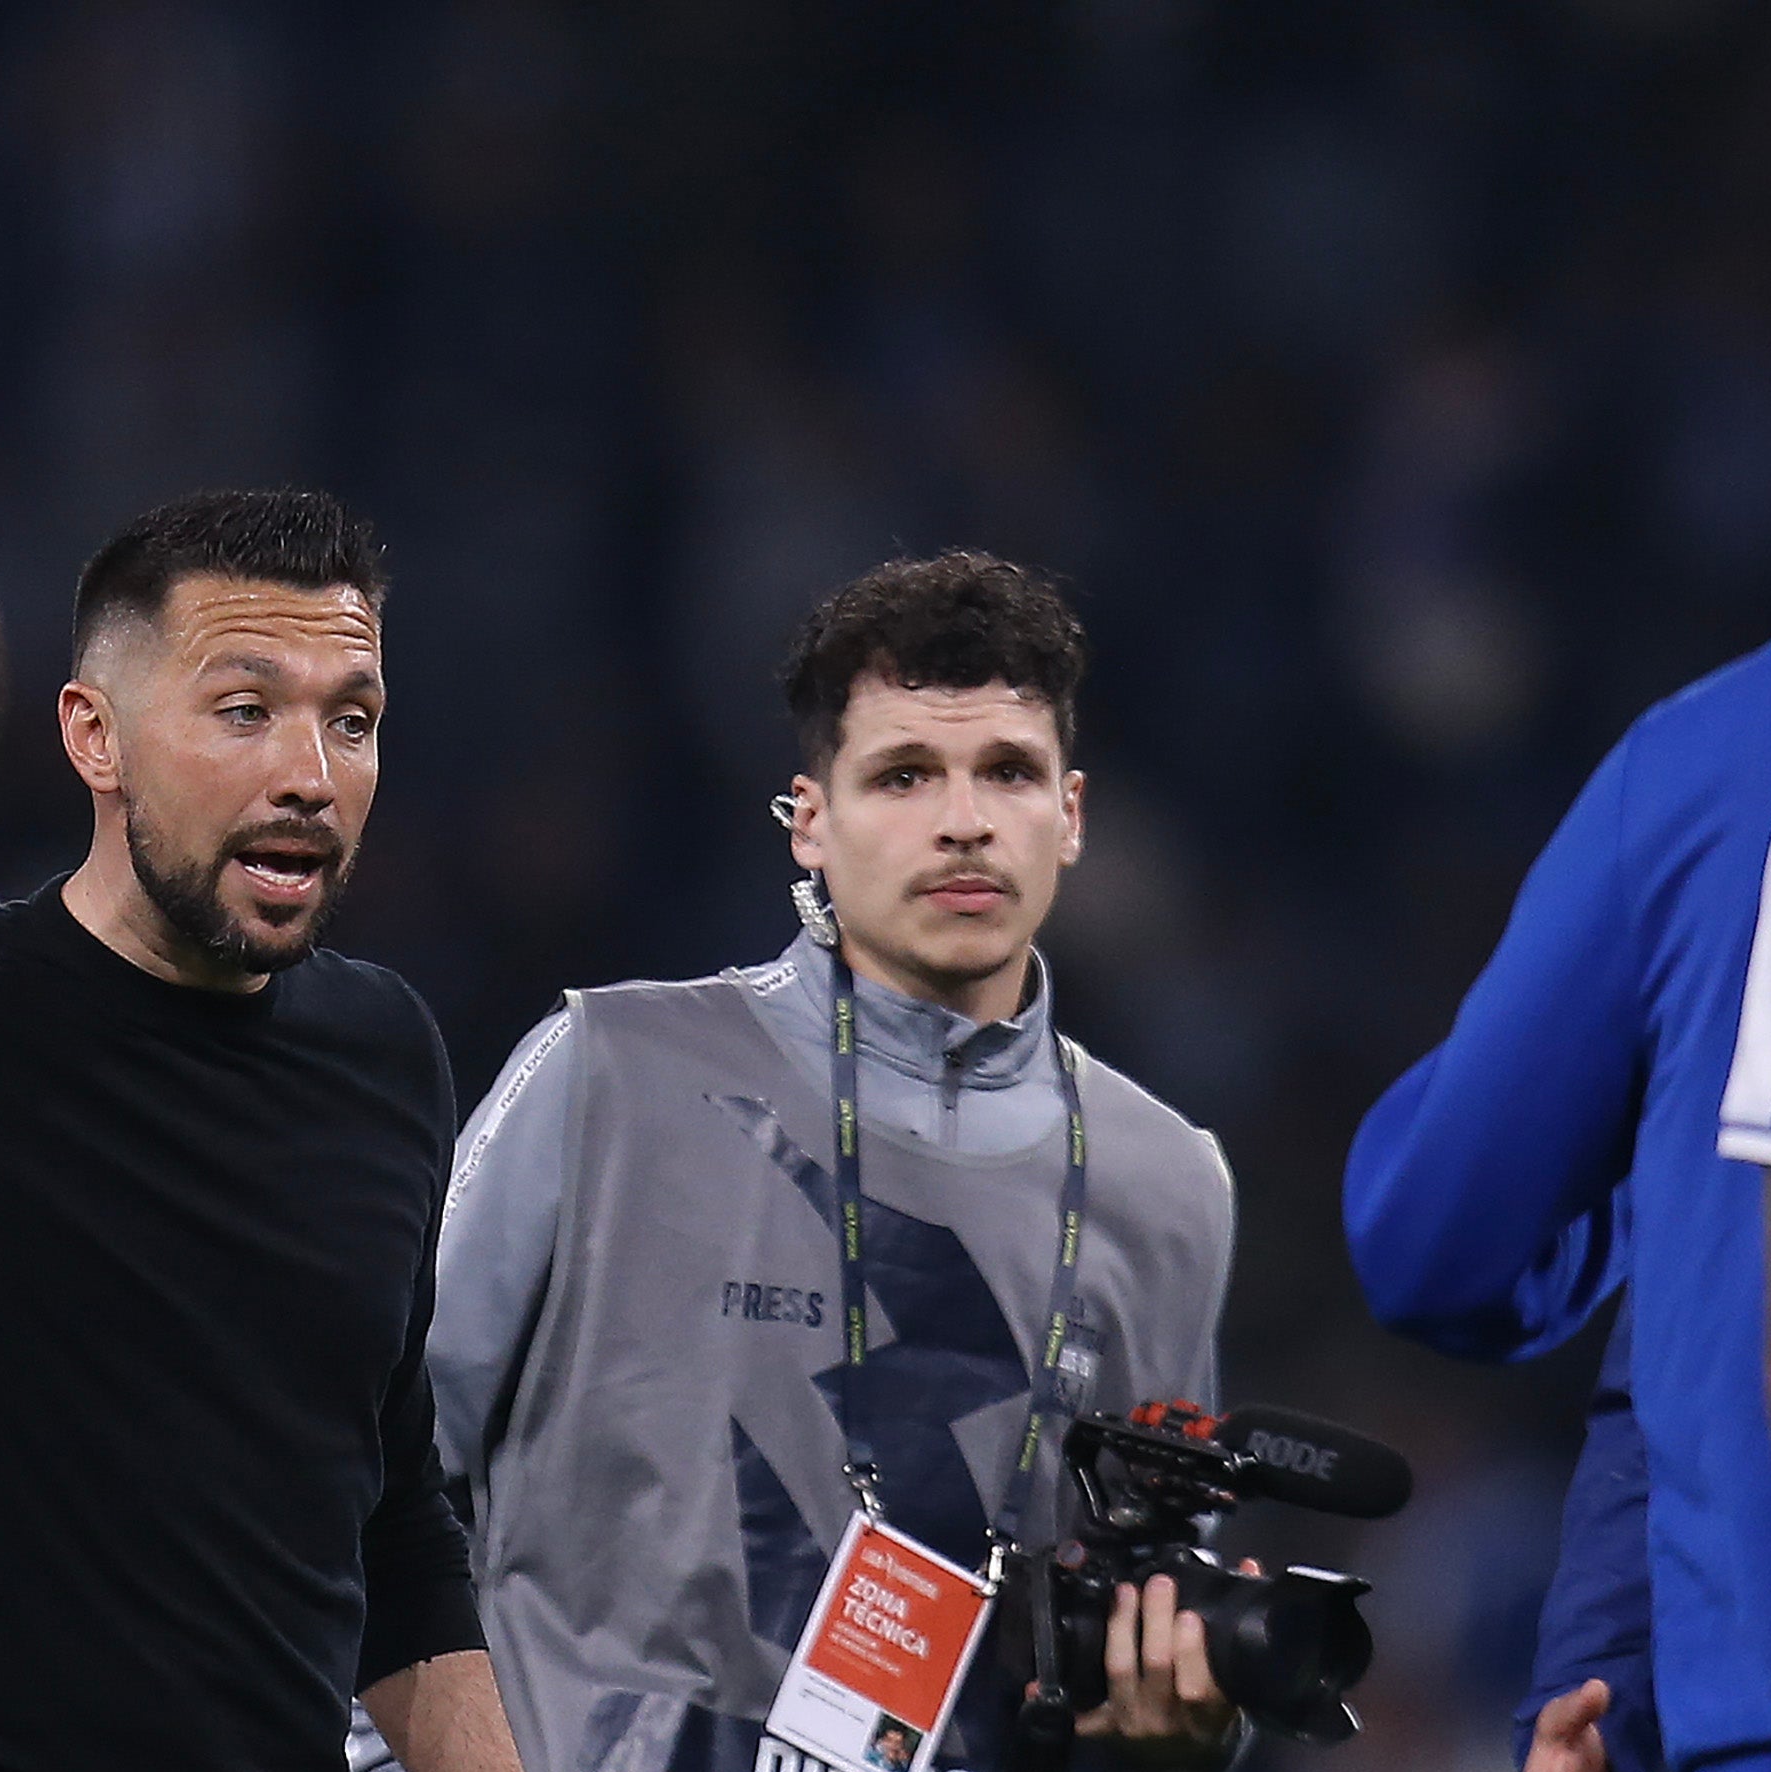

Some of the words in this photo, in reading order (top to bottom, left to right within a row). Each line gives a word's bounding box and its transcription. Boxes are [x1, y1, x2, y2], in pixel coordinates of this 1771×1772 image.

[523, 1018, 570, 1072] balanc
[722, 1282, 824, 1328] PRESS
[848, 1573, 909, 1621] ZONA
